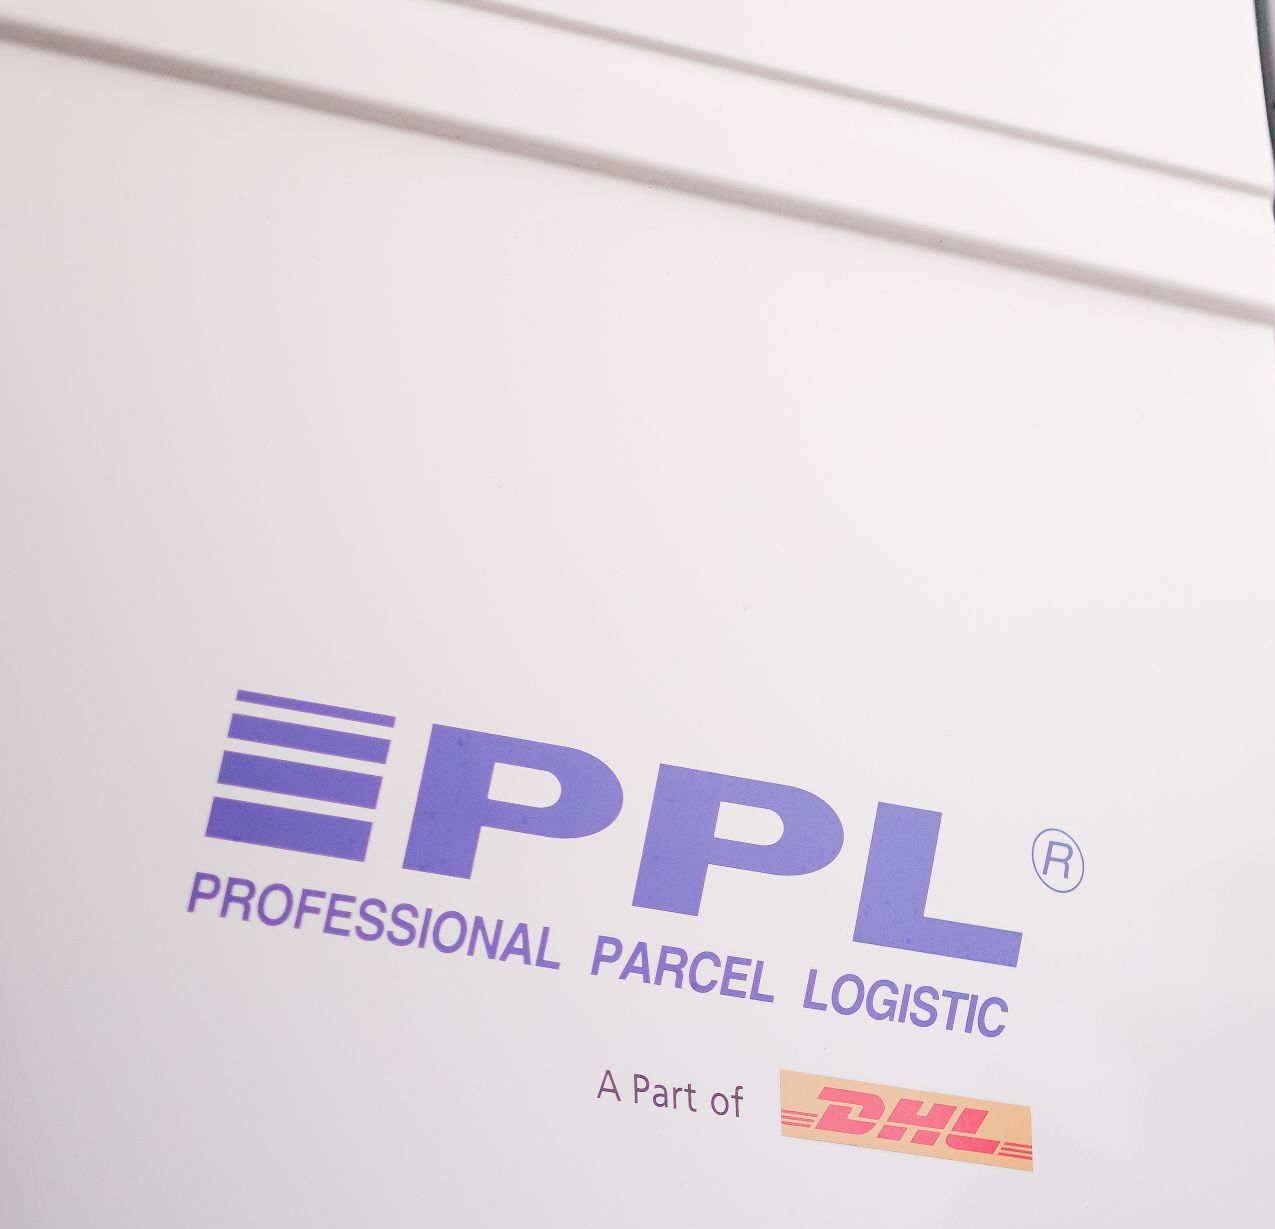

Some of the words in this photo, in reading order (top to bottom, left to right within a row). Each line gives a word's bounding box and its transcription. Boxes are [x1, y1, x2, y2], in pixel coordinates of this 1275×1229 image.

[187, 872, 560, 969] PROFESSIONAL
[591, 935, 774, 1003] PARCEL
[803, 969, 1008, 1037] LOGISTIC
[597, 1070, 621, 1101] A
[634, 1074, 697, 1113] Part
[711, 1086, 744, 1118] of
[816, 1086, 999, 1155] DHL
